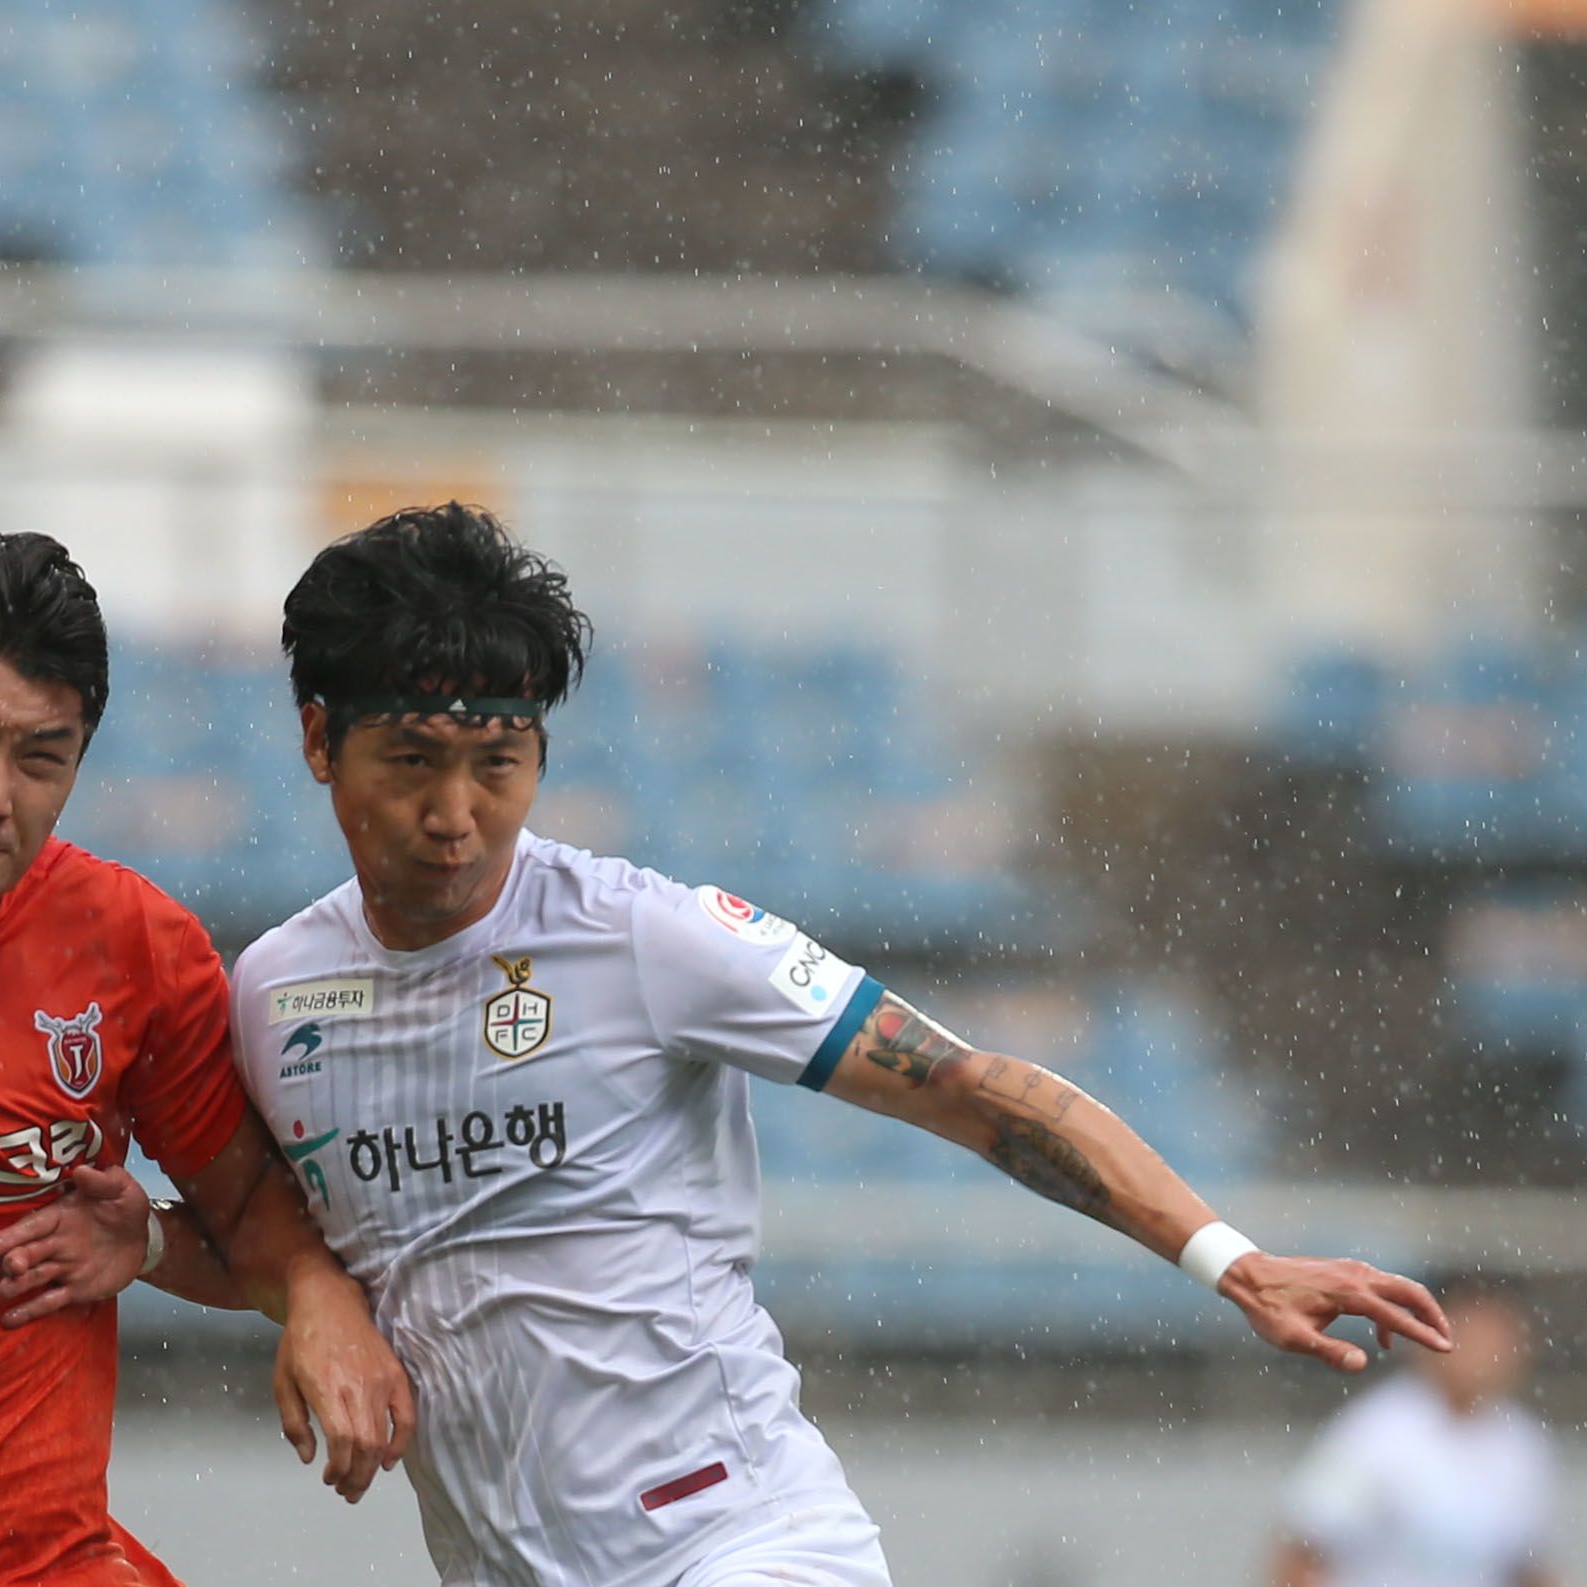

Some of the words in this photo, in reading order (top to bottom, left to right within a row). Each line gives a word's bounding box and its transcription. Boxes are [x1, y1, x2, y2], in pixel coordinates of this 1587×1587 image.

[292, 989, 364, 1012] 하나금융투자
[279, 1061, 322, 1079] ASTORE
[346, 1102, 567, 1192] 하나은행
